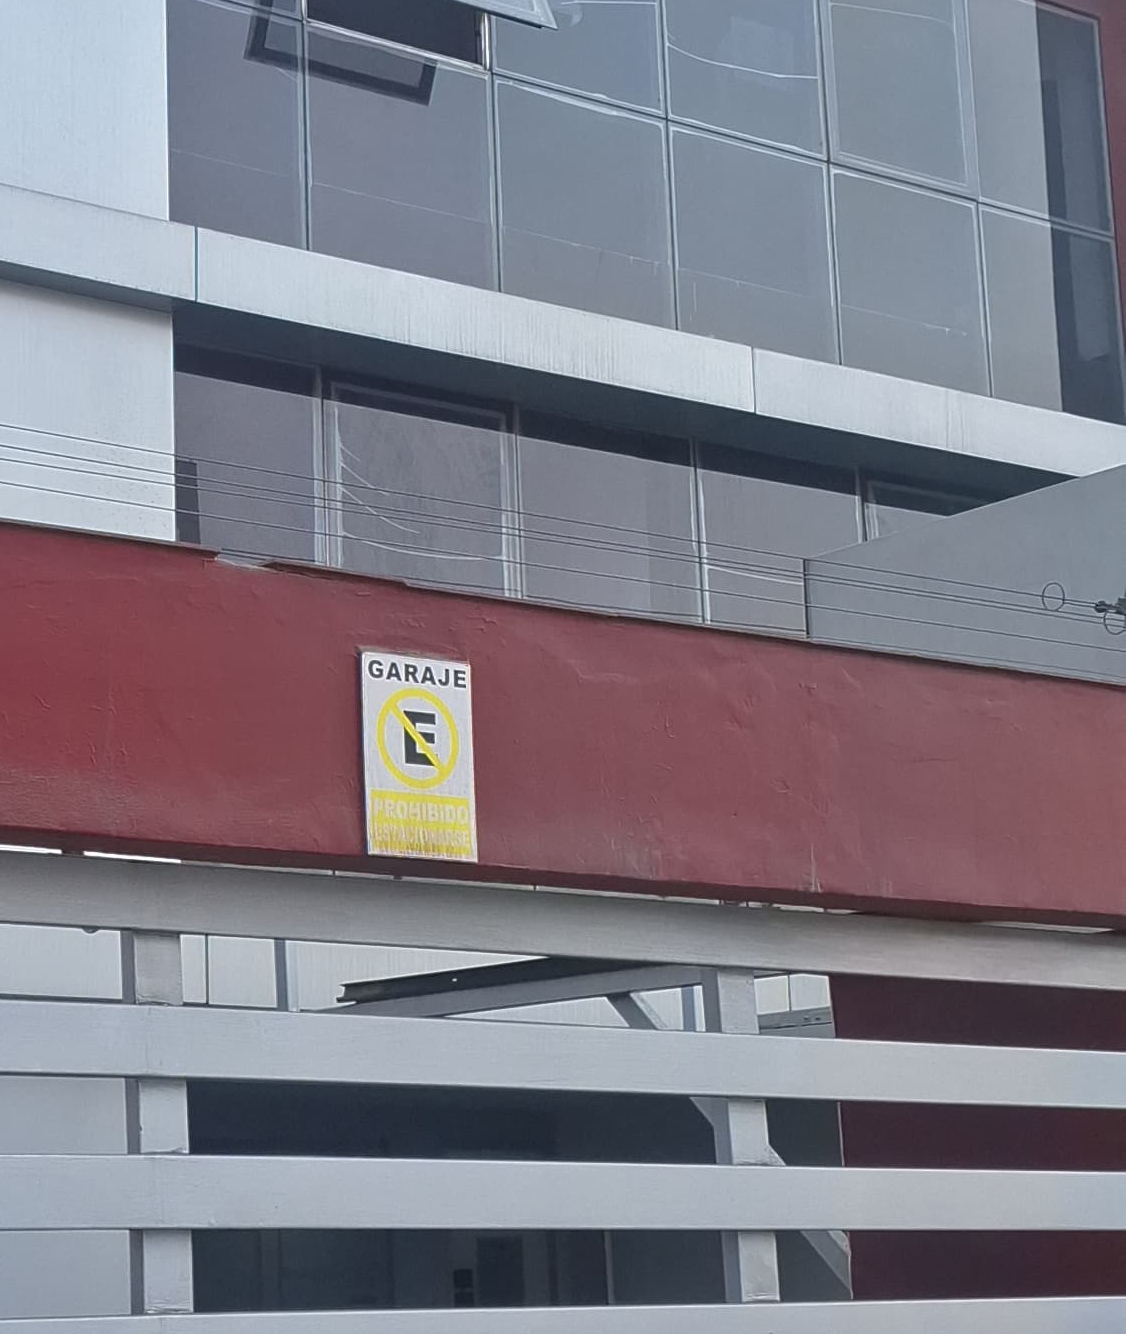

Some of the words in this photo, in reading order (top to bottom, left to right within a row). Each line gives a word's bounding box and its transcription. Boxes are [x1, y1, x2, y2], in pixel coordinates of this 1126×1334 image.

[367, 659, 467, 688] GARAJE
[402, 710, 437, 767] E
[373, 798, 469, 823] PROHIBIDO
